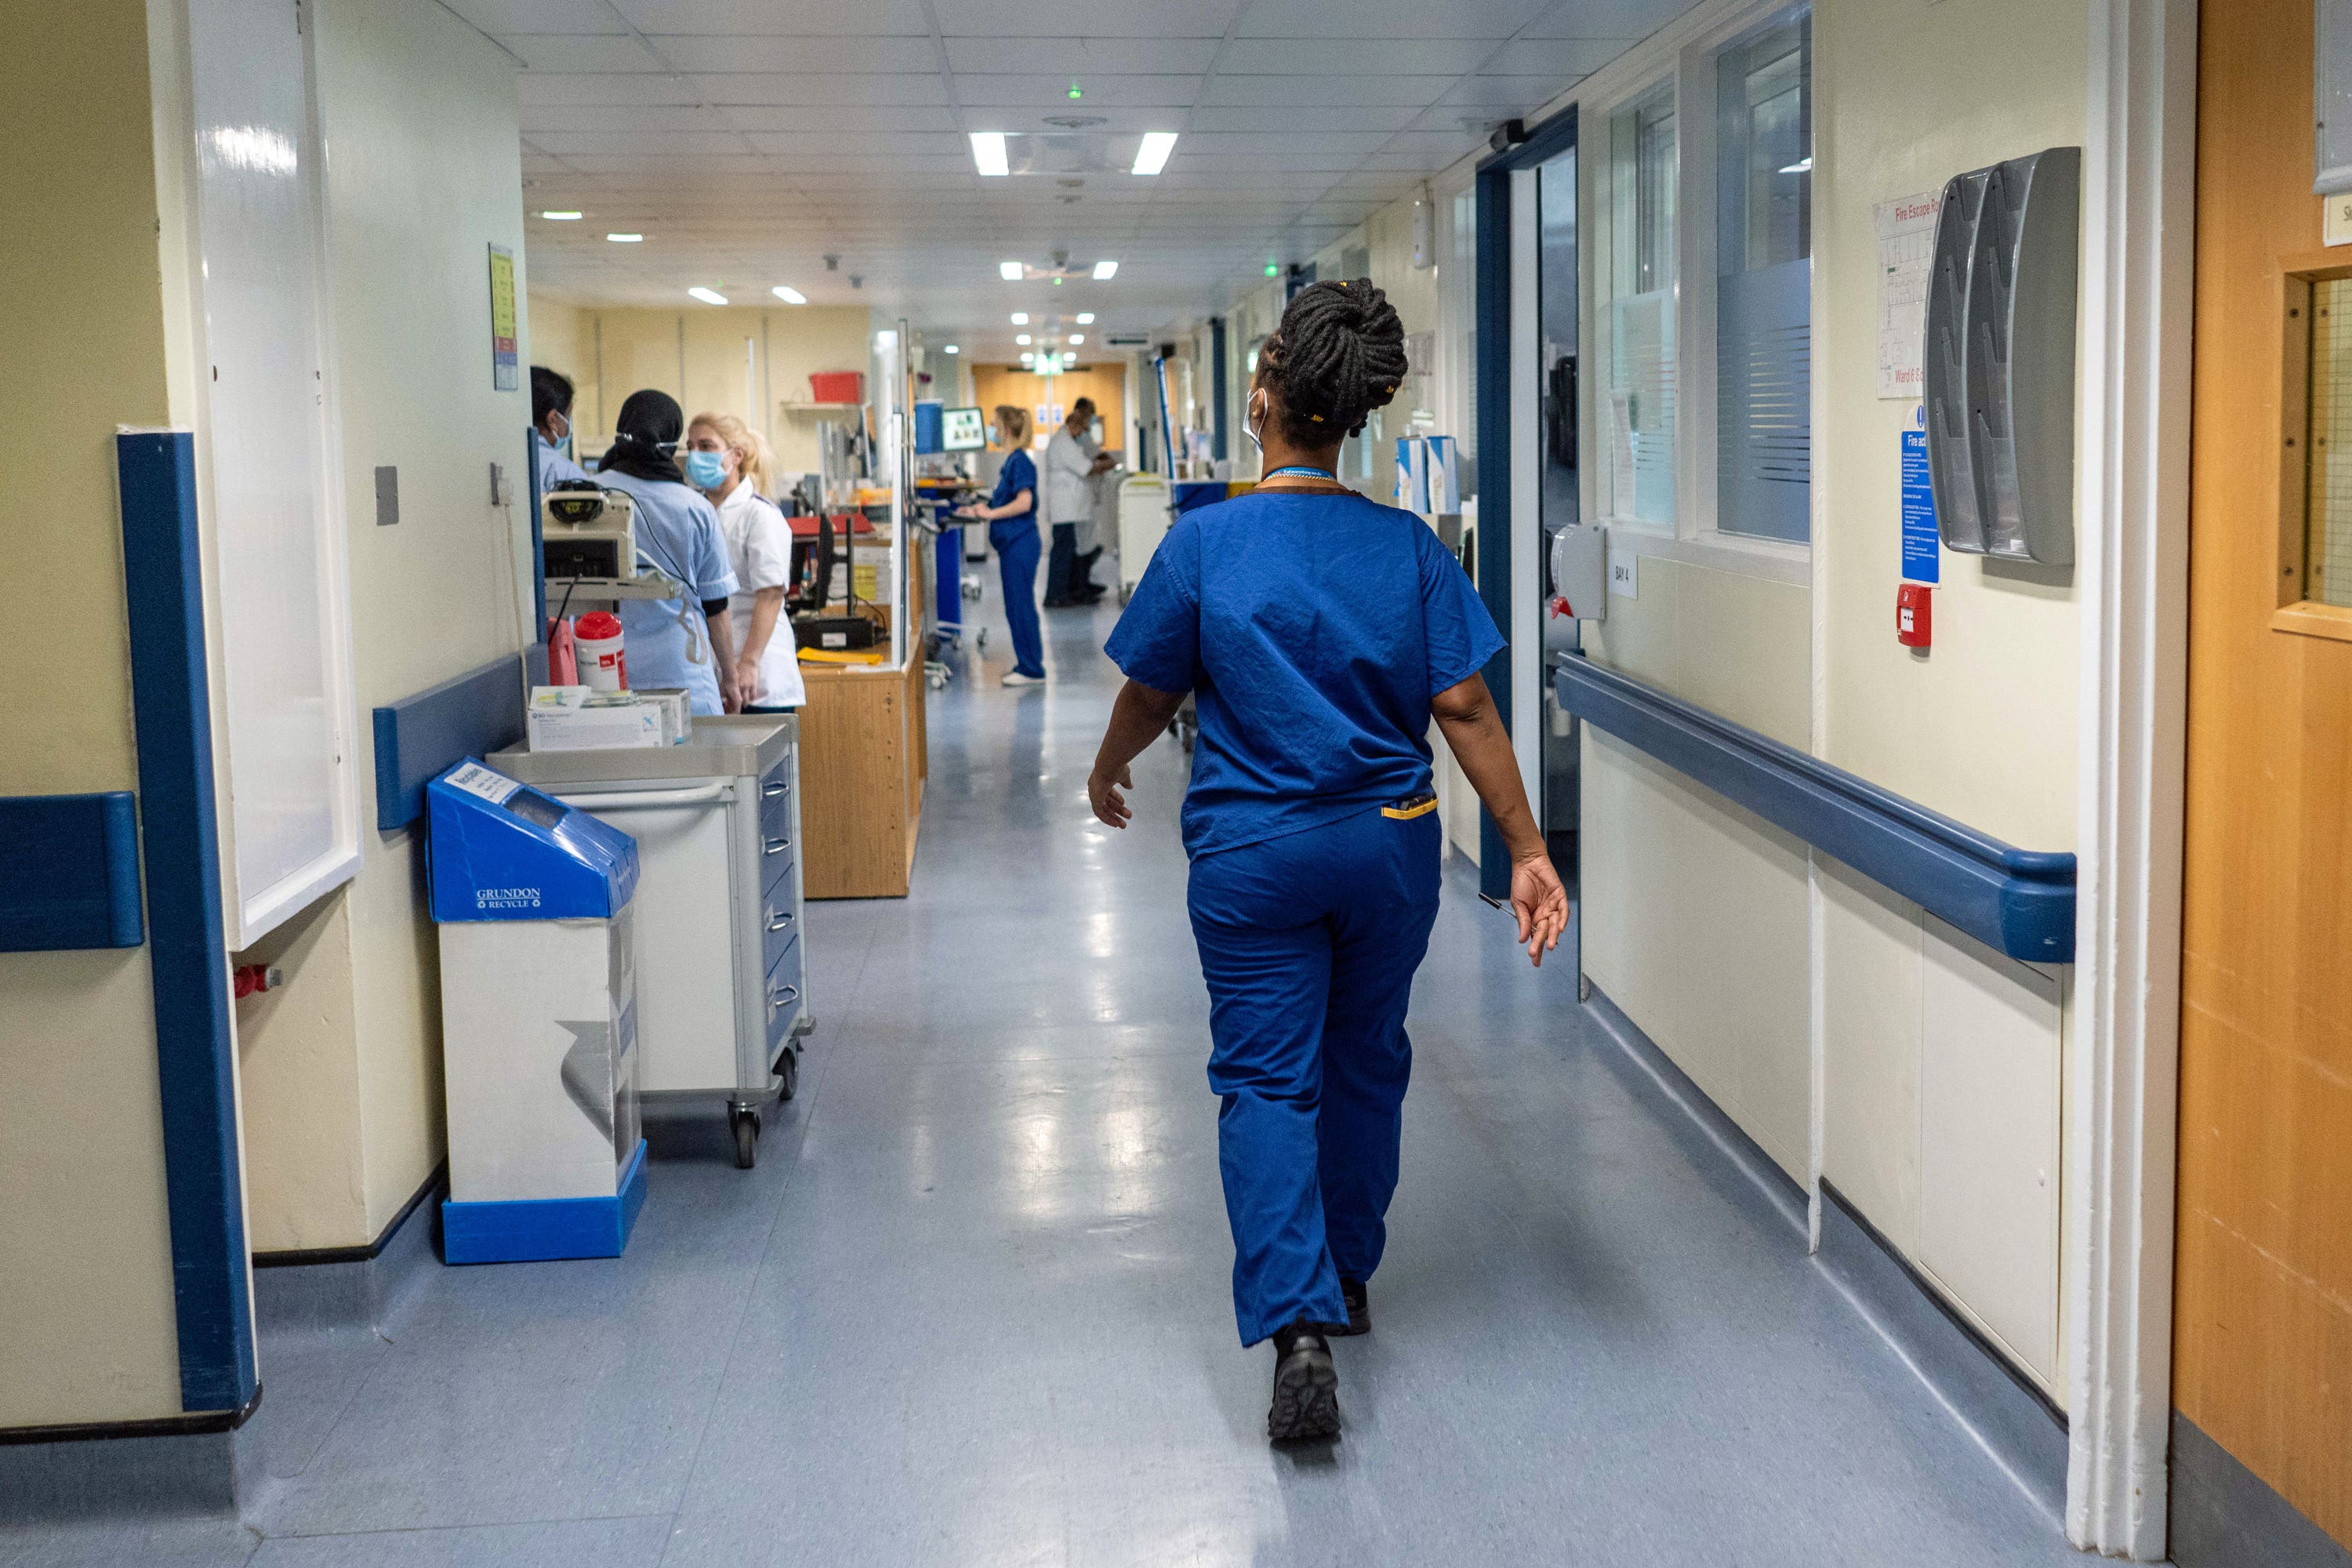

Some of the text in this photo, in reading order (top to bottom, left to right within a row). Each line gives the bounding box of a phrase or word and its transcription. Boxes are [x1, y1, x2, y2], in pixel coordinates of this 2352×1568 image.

[1895, 198, 1940, 222] Fire Escape Ro
[1895, 368, 1910, 383] Ward
[1911, 368, 1915, 383] 6
[1907, 434, 1918, 447] Fire
[1615, 564, 1624, 581] BAY
[477, 887, 541, 899] GRUNDON
[488, 900, 529, 909] RECYCLE
